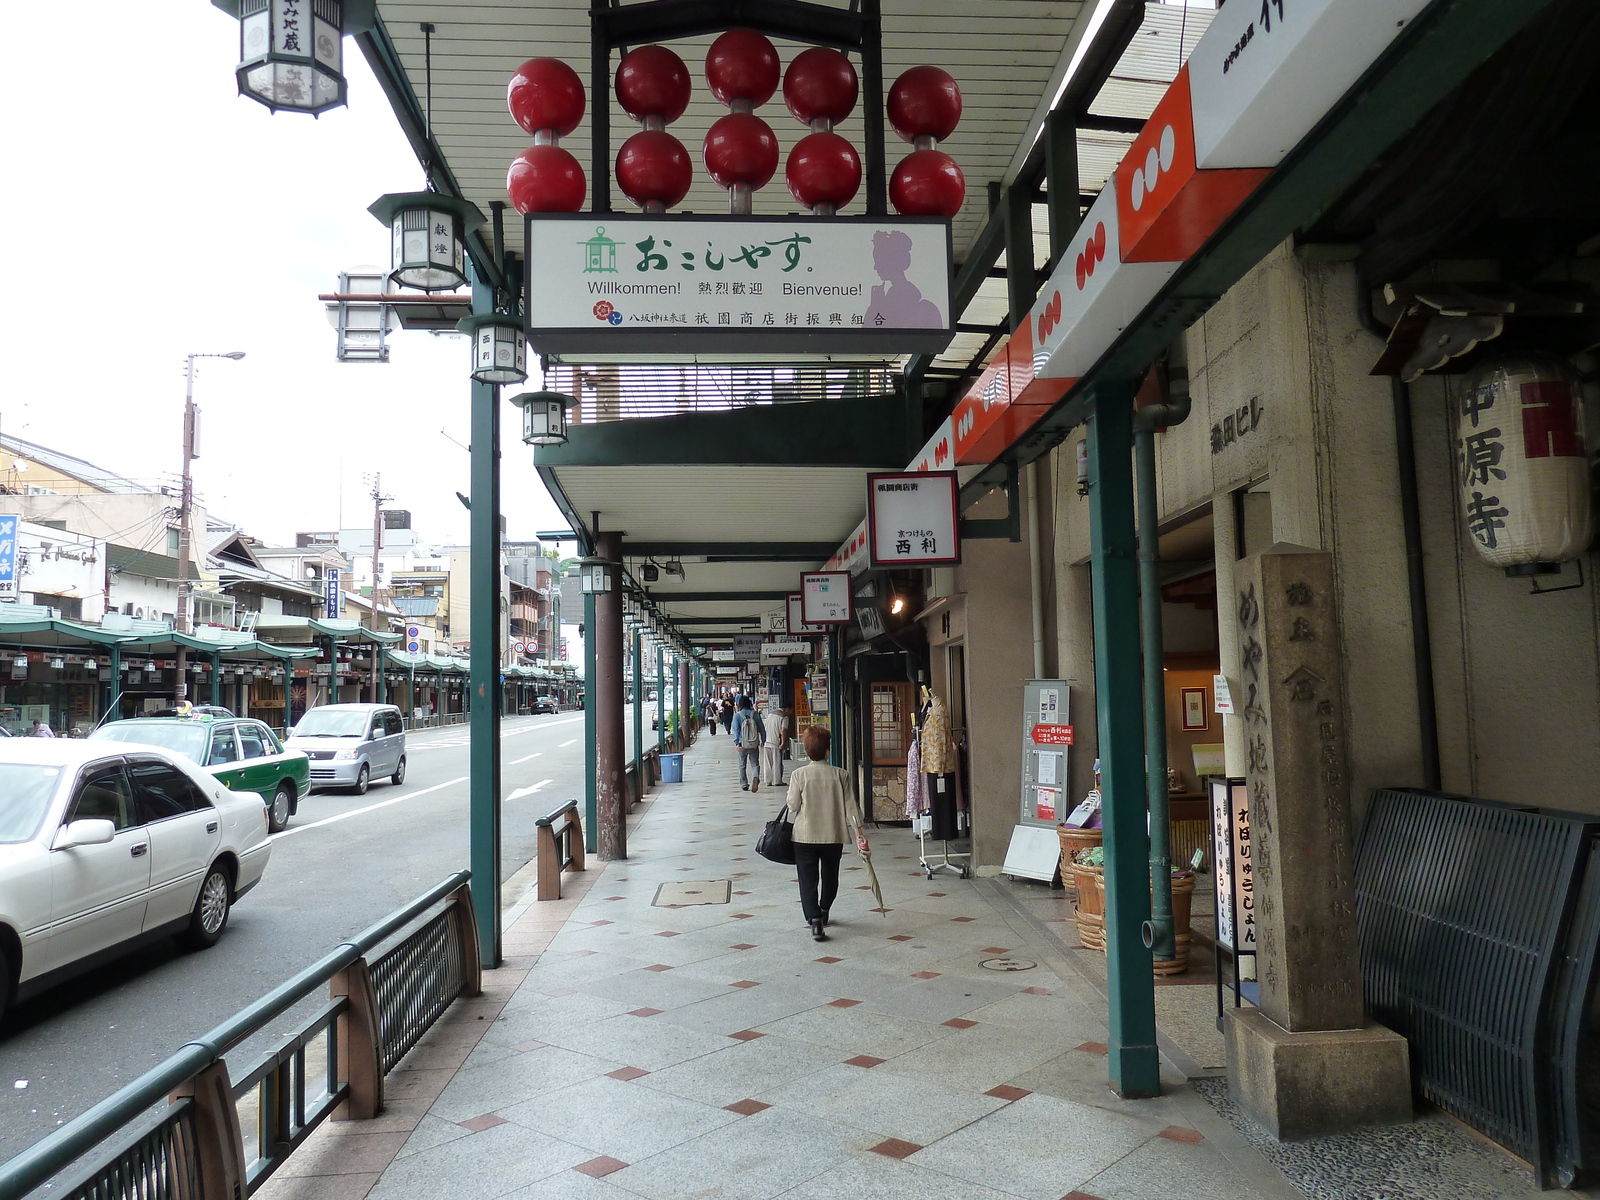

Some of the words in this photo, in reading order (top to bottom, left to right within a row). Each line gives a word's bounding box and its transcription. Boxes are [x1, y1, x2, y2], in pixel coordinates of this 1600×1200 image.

[587, 281, 681, 295] Willkommen!
[698, 281, 763, 296] 熱烈歡迎
[782, 282, 863, 296] Bienvenue!
[877, 483, 919, 492] 祇園商店街
[897, 529, 934, 538] 京つけもの
[895, 537, 937, 554] 西利
